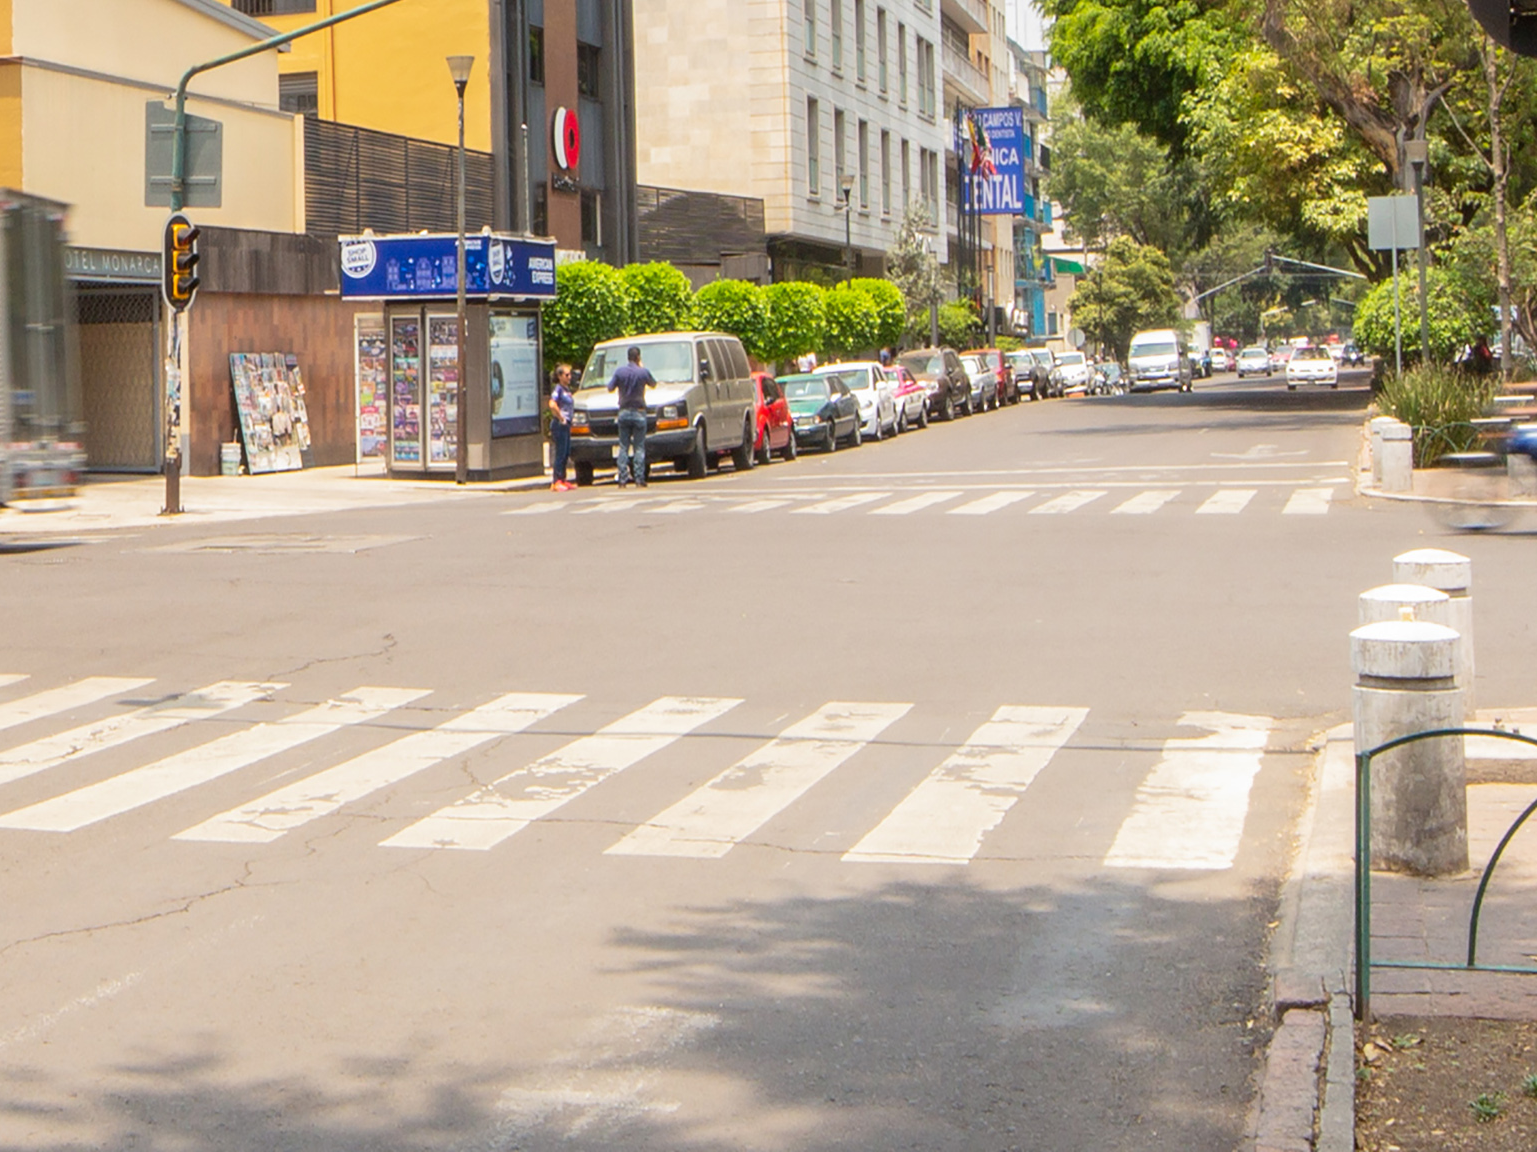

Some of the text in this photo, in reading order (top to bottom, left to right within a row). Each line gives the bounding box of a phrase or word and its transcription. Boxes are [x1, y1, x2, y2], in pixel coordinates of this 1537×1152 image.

[982, 112, 1014, 127] CAMPOS
[348, 247, 367, 256] SHOP
[65, 250, 161, 274] OTEL MONARCA
[347, 254, 369, 264] SMALL
